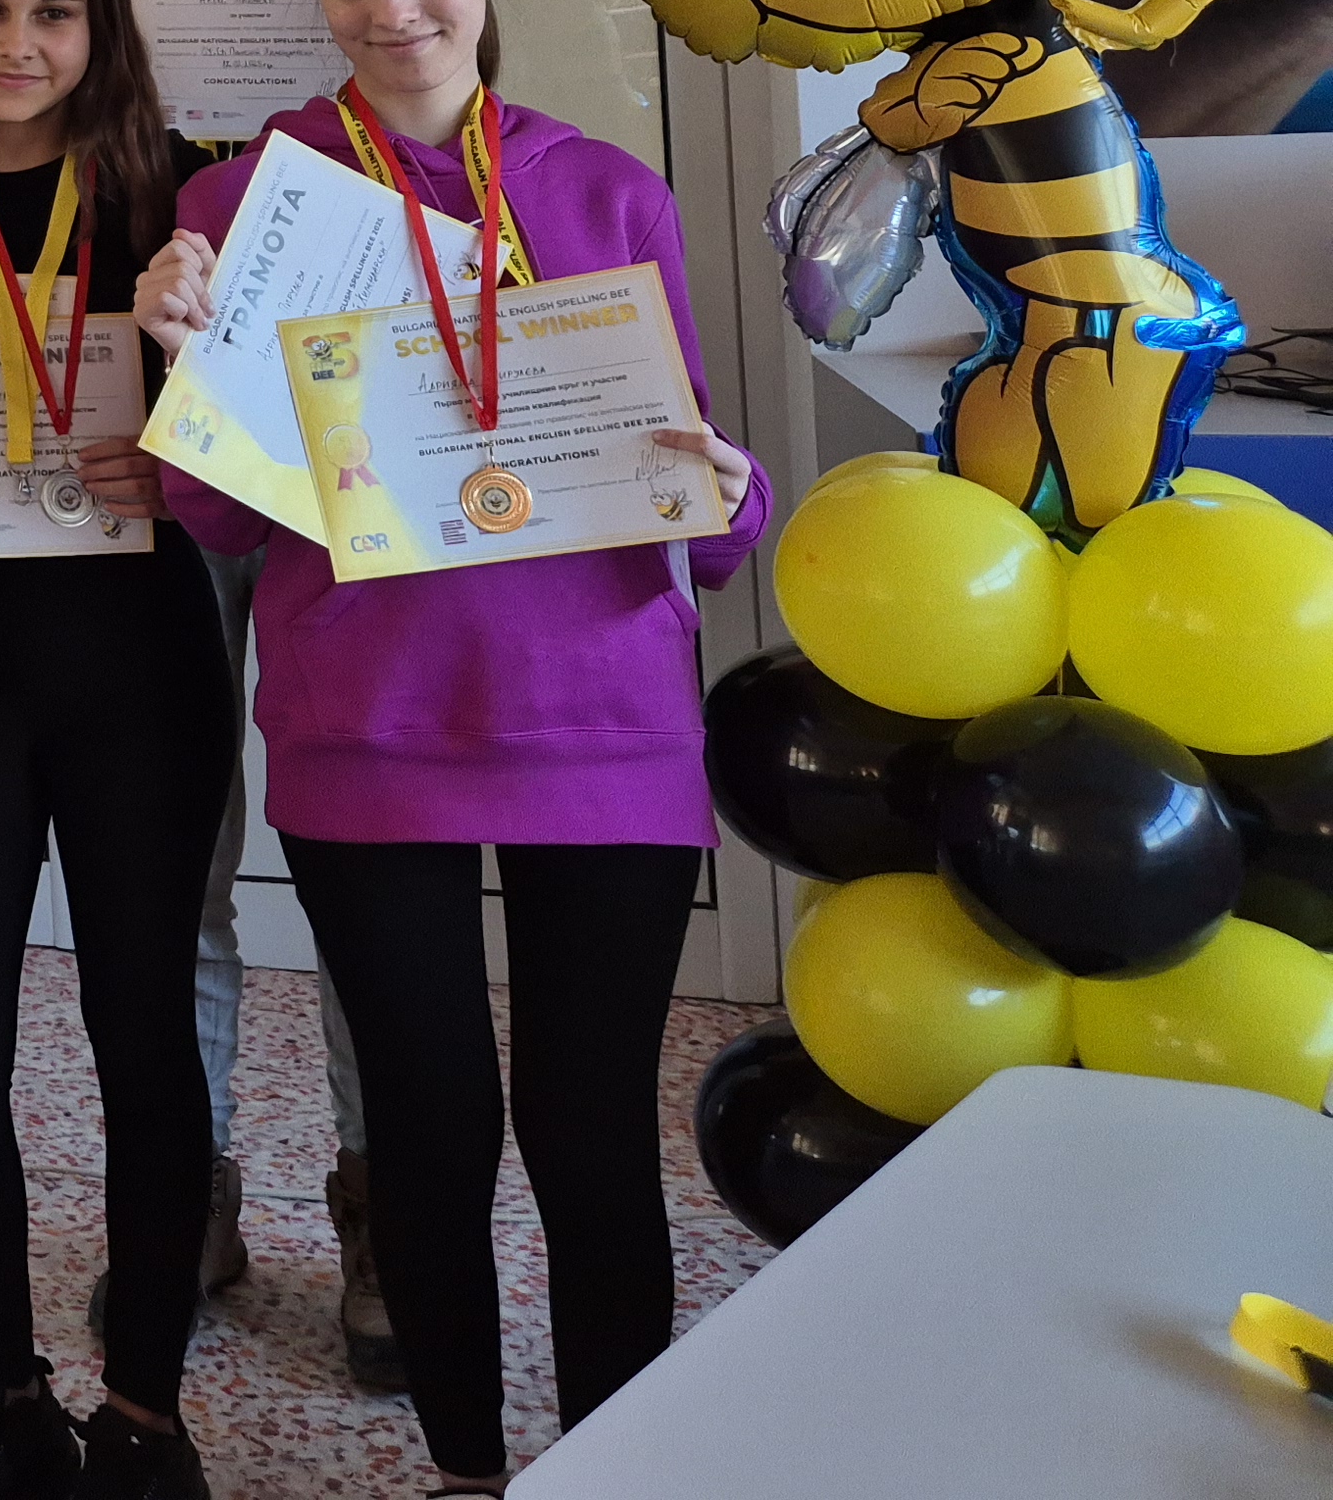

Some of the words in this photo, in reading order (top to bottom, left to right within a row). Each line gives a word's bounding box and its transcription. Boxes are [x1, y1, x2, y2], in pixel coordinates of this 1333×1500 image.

[357, 128, 369, 146] BEE
[468, 129, 487, 184] BULGARIAN
[223, 189, 306, 351] ГРАМОТА
[350, 252, 369, 288] SPELLING
[365, 233, 377, 251] BEE
[509, 302, 554, 317] ENGLISH
[556, 292, 608, 309] SPELLING
[610, 287, 630, 299] BEE
[94, 333, 112, 341] BEE
[203, 304, 229, 354] BULGARIAN
[518, 303, 639, 339] WINNER
[312, 370, 335, 381] BEE
[434, 399, 463, 409] Първо
[558, 381, 579, 392] кръг
[590, 374, 627, 387] участие
[533, 394, 602, 411] квалификация
[419, 443, 473, 456] BULGARIAN
[529, 429, 571, 442] ENGLISH
[574, 423, 620, 435] SPELLING
[623, 420, 643, 428] BEE
[646, 415, 669, 425] 2025
